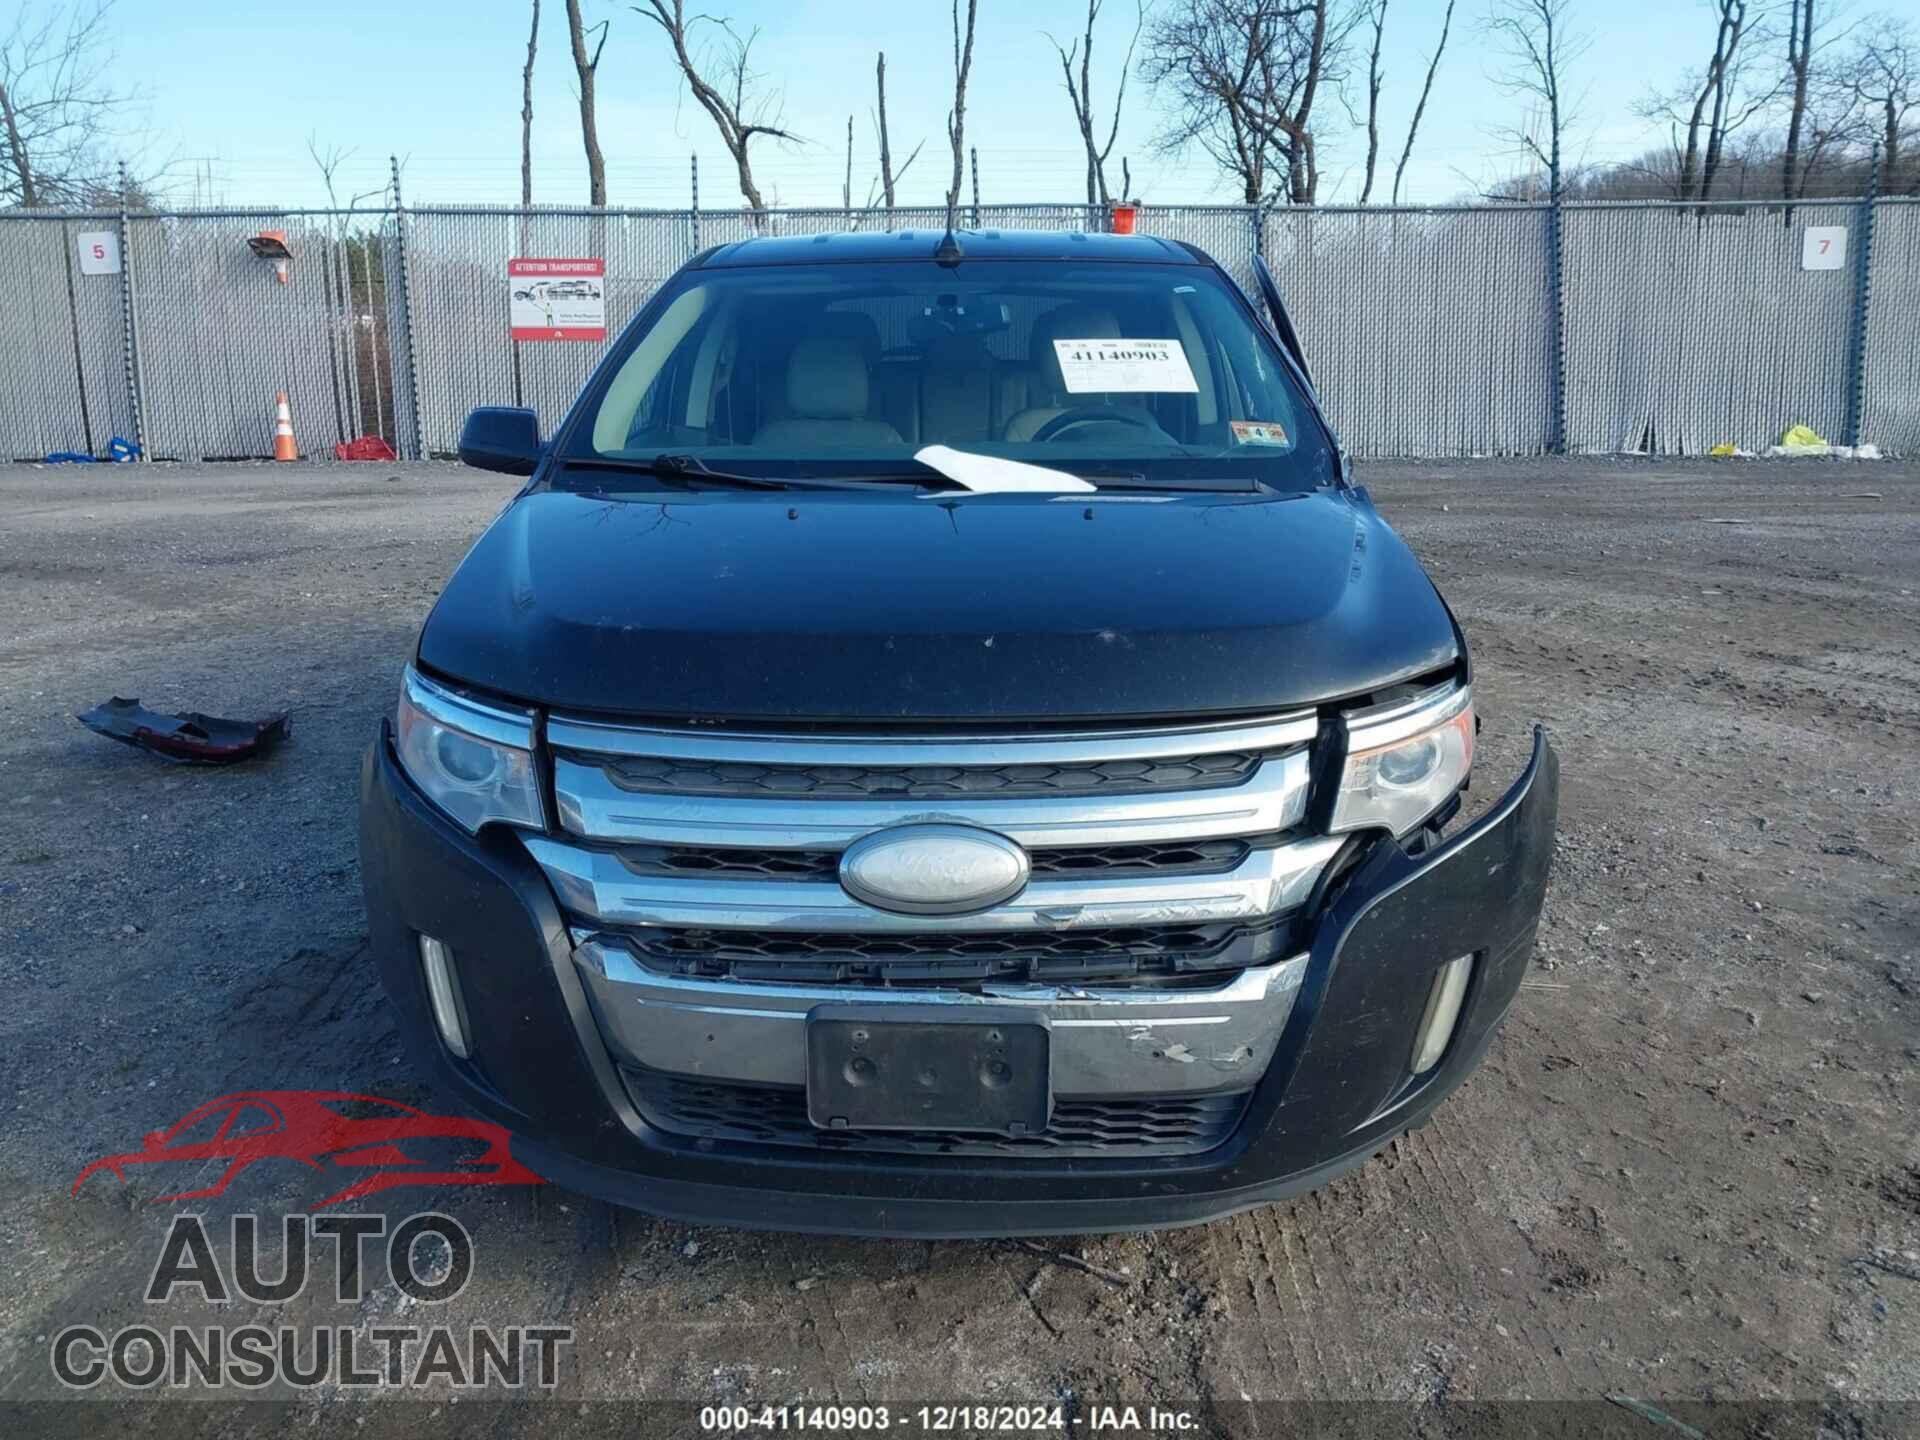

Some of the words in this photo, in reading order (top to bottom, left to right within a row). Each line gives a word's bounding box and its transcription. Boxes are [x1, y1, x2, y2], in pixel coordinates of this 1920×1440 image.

[93, 244, 104, 259] 5
[1819, 239, 1831, 255] 7
[515, 262, 547, 272] ATTENTION
[1072, 351, 1169, 361] 41140903
